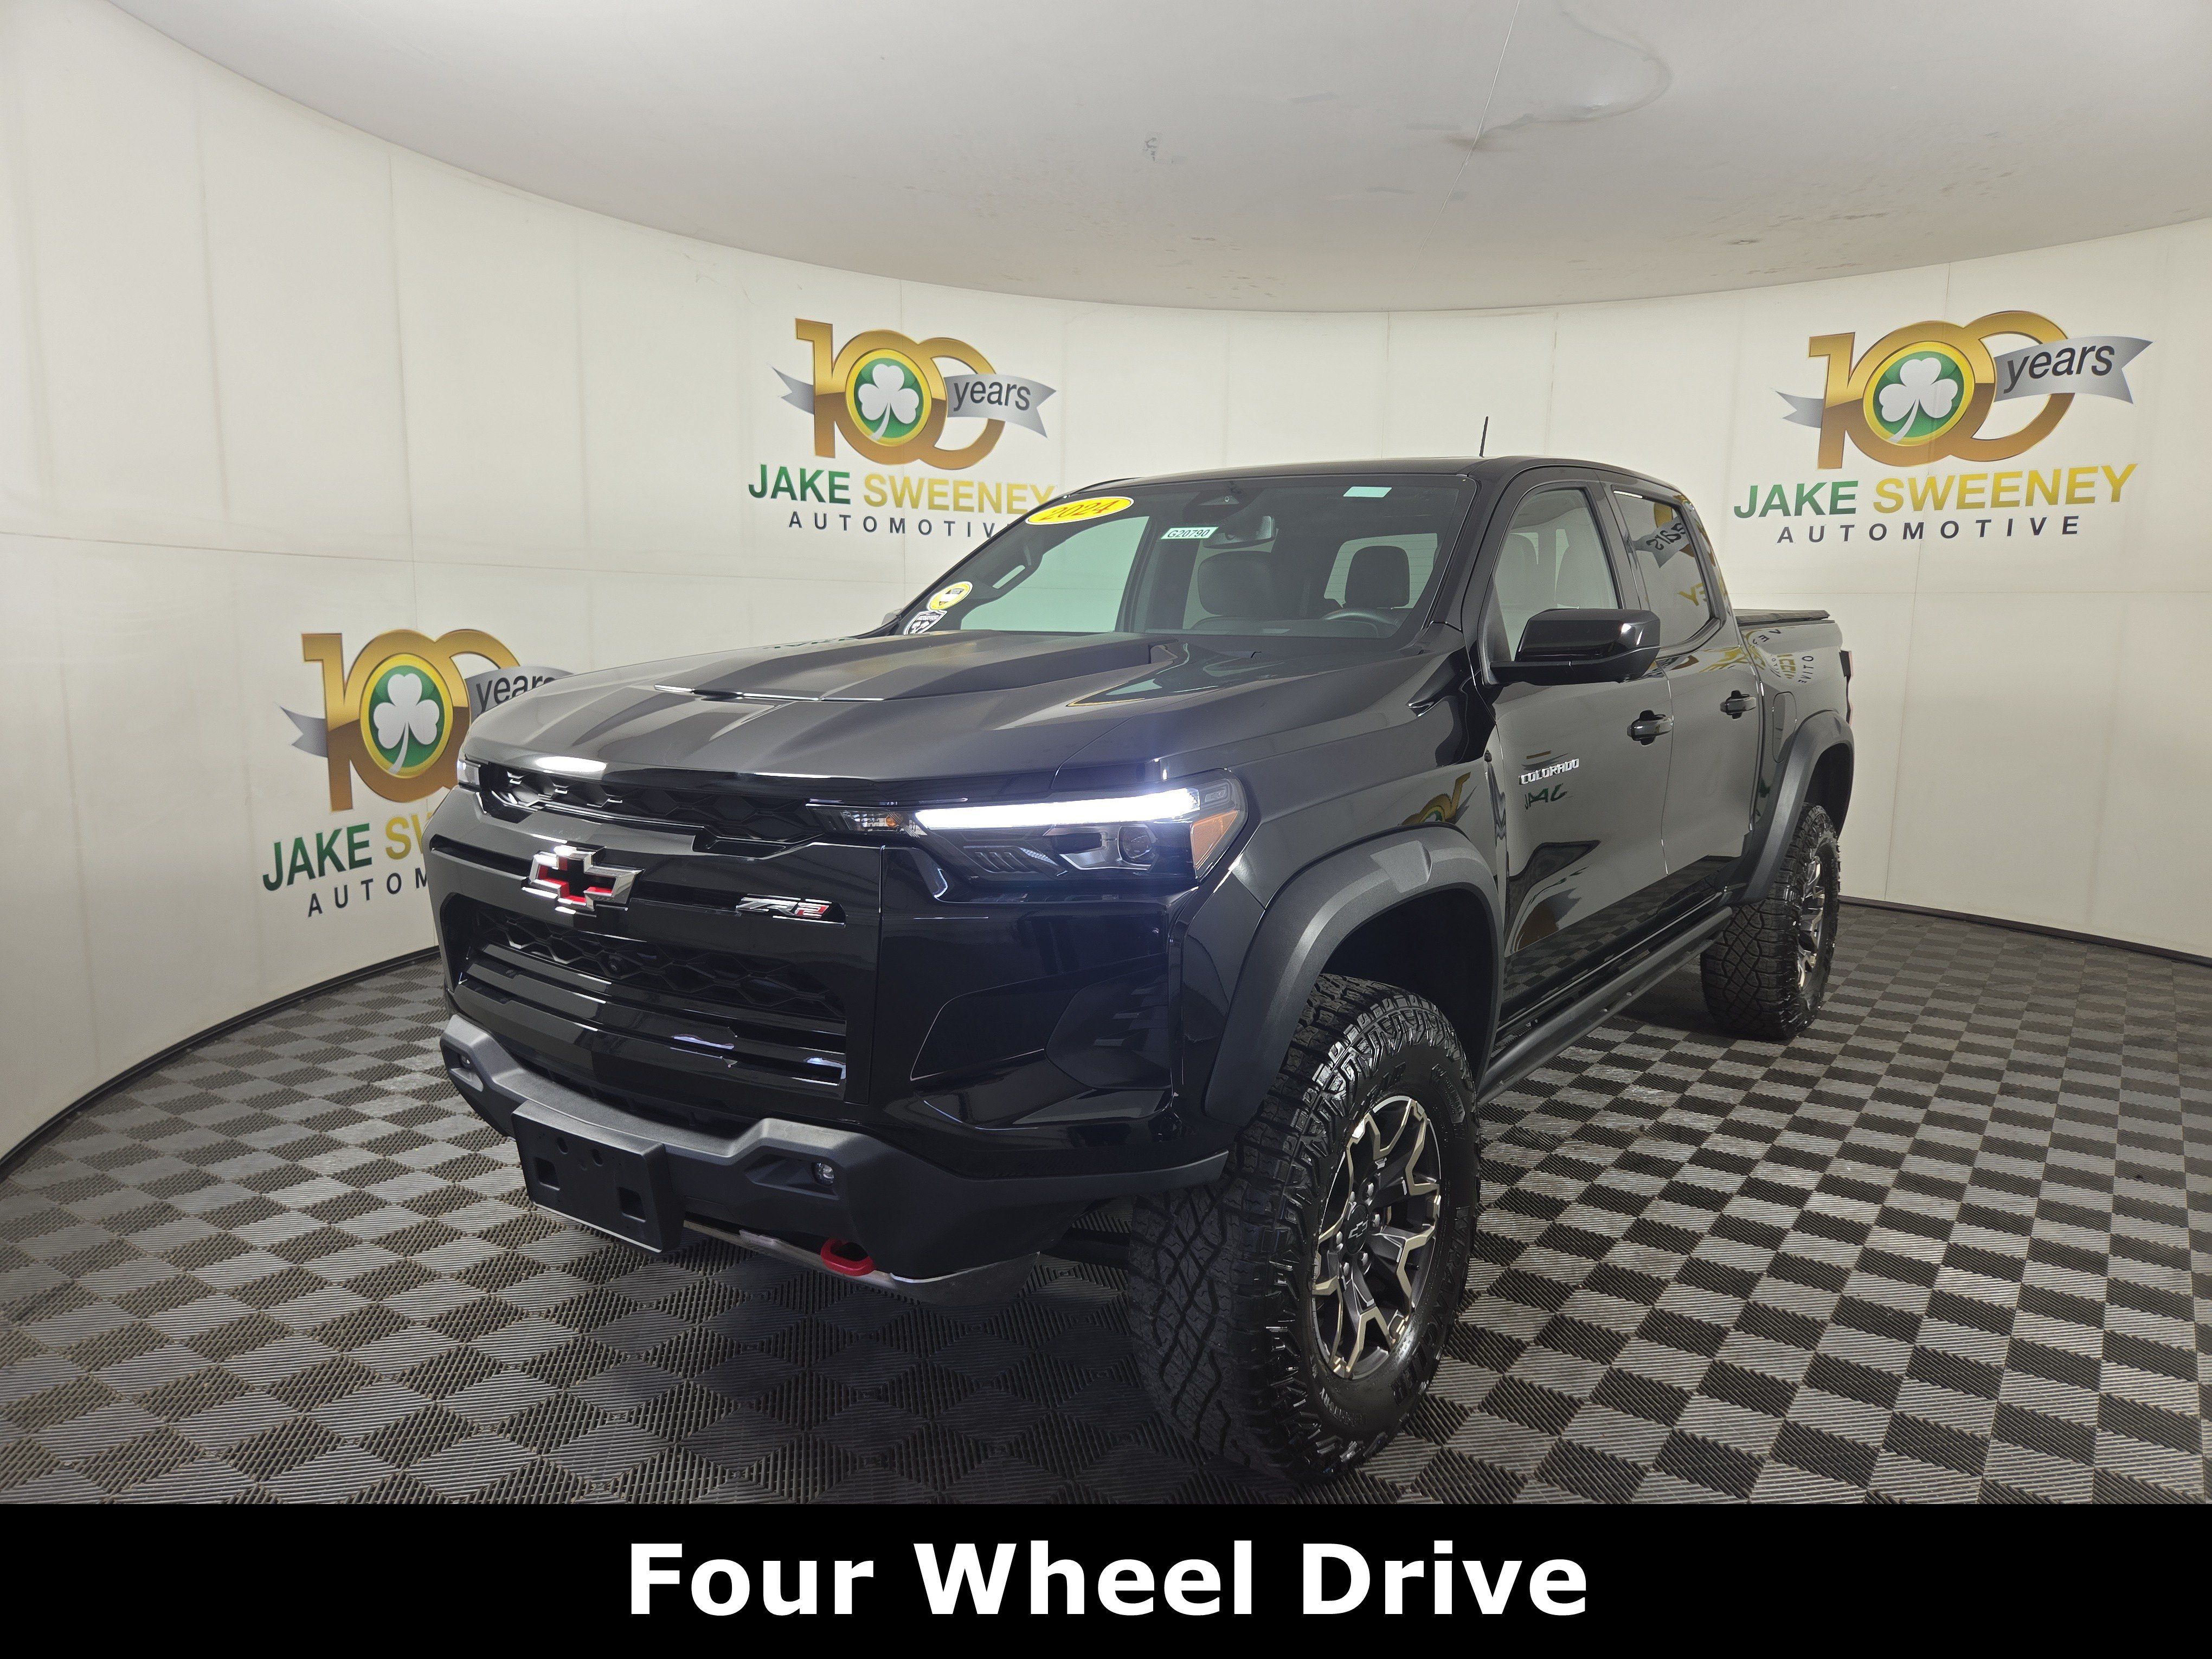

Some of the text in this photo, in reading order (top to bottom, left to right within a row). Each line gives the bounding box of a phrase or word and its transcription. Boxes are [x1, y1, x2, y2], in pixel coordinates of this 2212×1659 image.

[2004, 341, 2115, 394] years
[795, 318, 1005, 470] 100
[953, 380, 1031, 411] years
[1808, 310, 2075, 471] 100
[748, 464, 1055, 515] JAKE SWEENEY
[1733, 463, 2138, 519] JAKE SWEENEY
[789, 511, 1010, 538] AUTOMOTIV
[1038, 500, 1121, 520] 2024
[1167, 530, 1210, 538] G20790
[1777, 516, 2080, 544] AUTOMOTIVE
[1519, 758, 1579, 785] COLORADO
[263, 822, 372, 891] JAKE
[736, 897, 829, 918] ZR2
